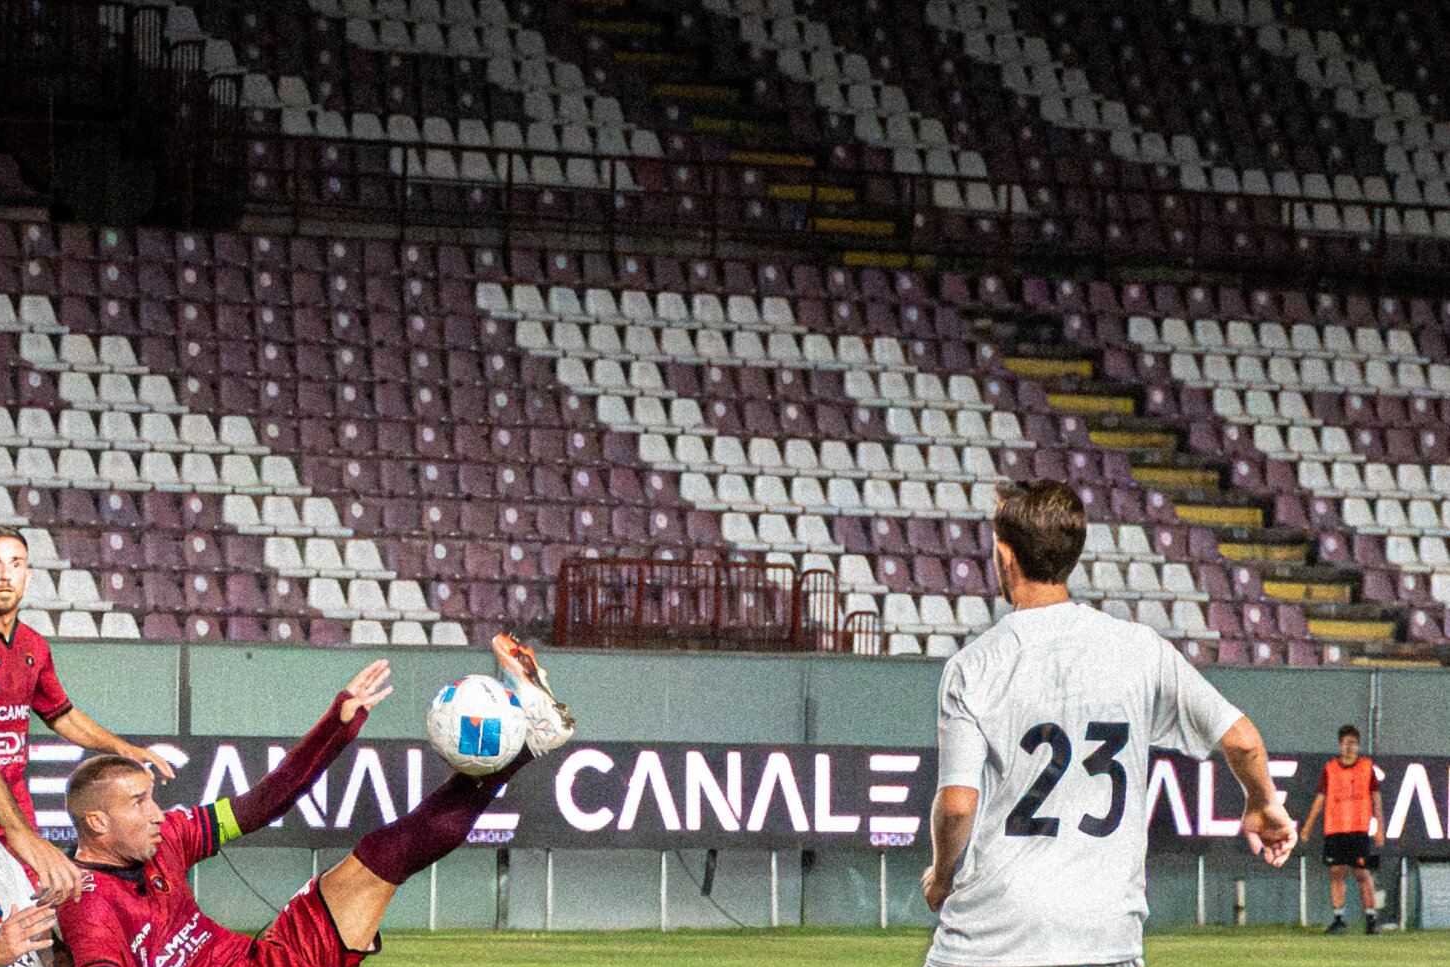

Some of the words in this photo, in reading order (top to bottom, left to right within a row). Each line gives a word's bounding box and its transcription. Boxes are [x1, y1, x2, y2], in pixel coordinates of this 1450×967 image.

[555, 748, 922, 833] CANALE
[1005, 721, 1129, 837] 23
[870, 833, 916, 846] GROUP
